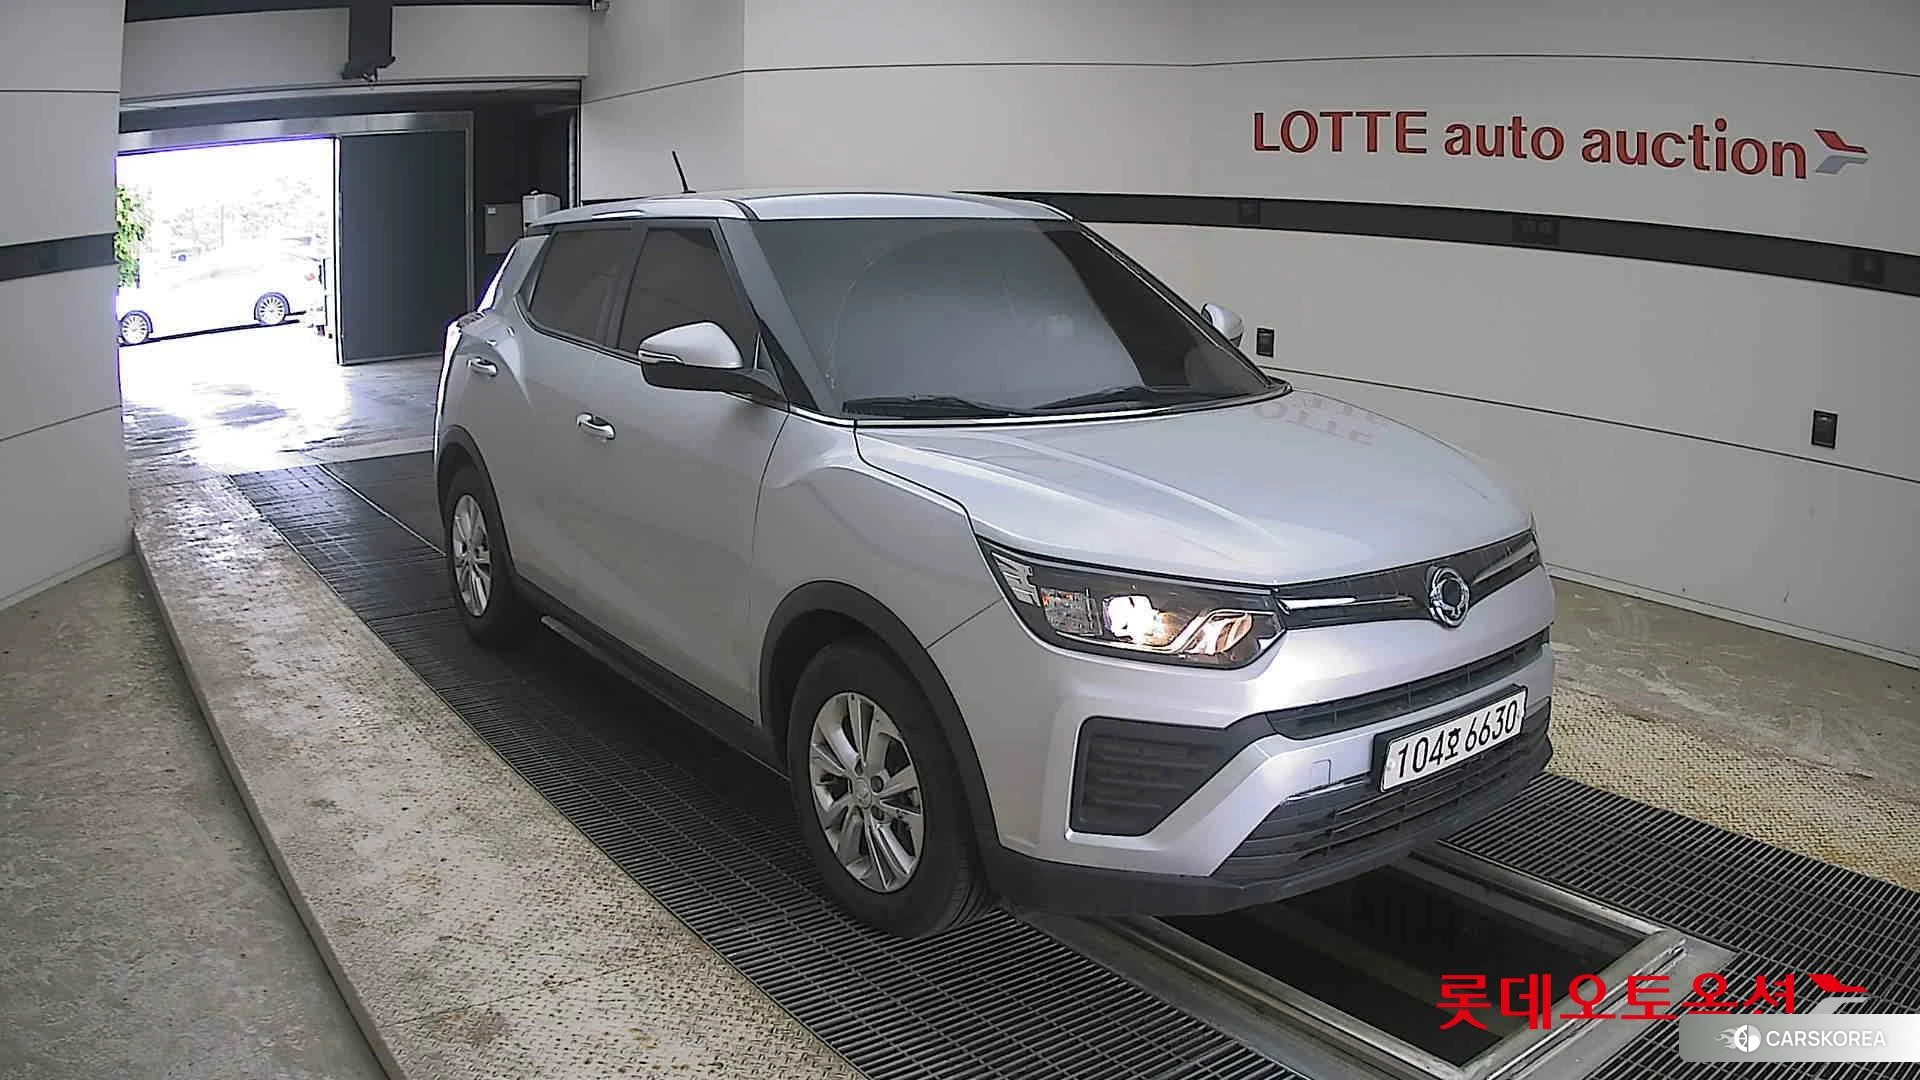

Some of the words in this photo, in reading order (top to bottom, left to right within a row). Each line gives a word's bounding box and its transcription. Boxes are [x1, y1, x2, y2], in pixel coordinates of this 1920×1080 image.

[1253, 110, 1428, 155] LOTTE
[1444, 115, 1565, 161] auto
[1581, 118, 1808, 179] auction
